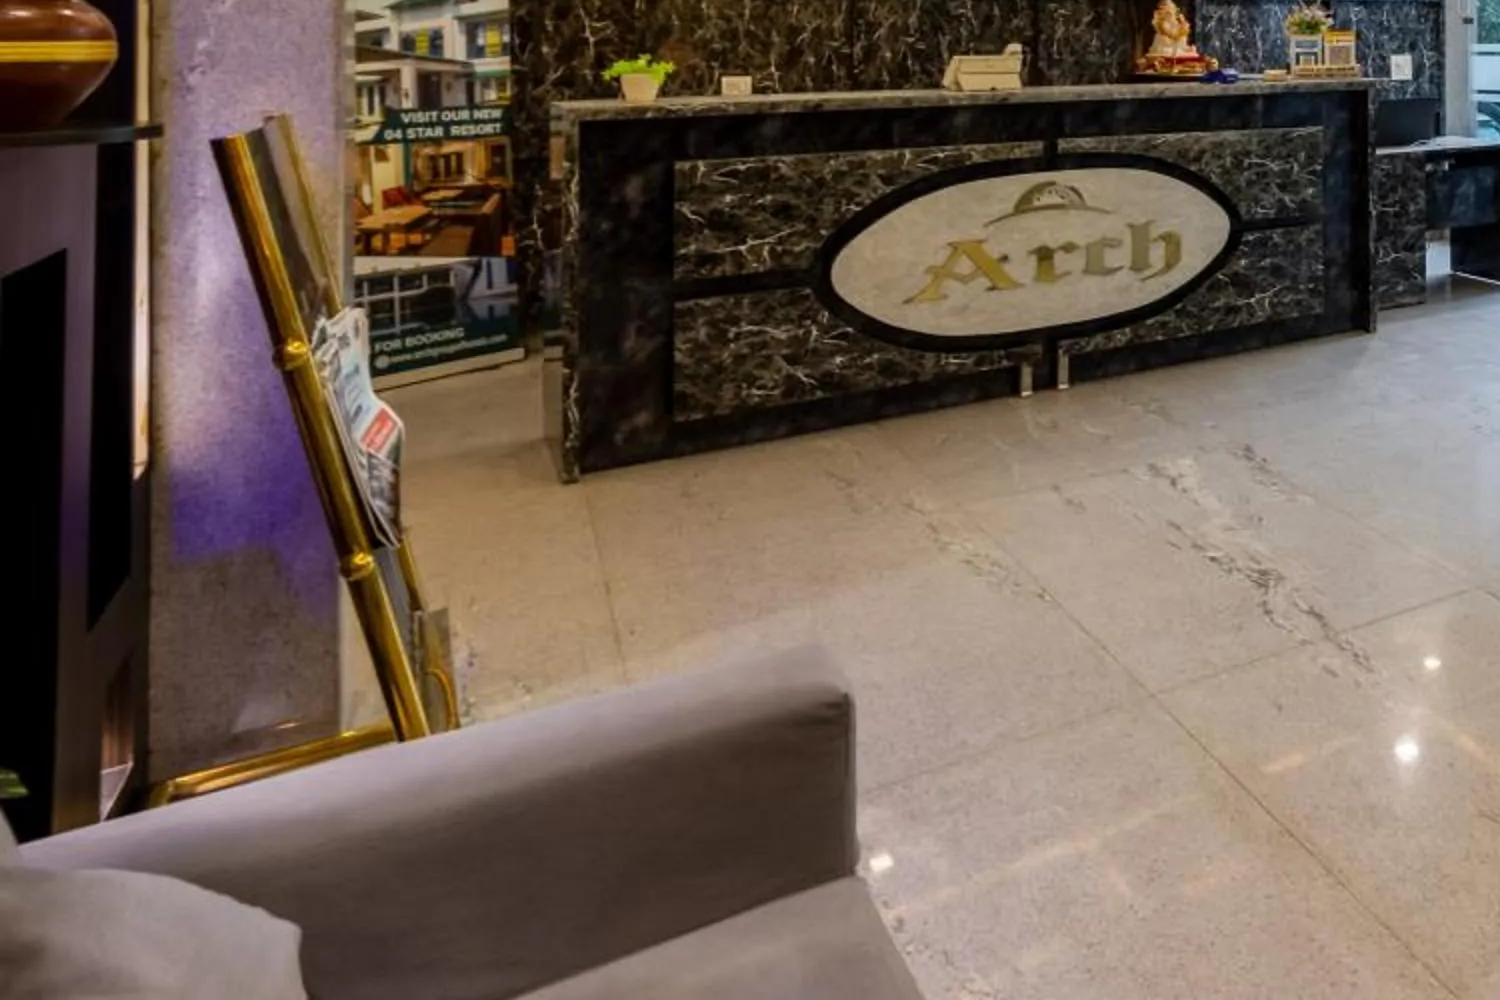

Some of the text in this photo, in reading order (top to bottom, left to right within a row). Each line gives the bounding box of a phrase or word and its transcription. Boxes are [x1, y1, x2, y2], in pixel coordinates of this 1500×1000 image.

[402, 109, 502, 123] VISIT OUR NEW
[406, 126, 444, 138] STAR
[451, 123, 501, 136] RESORT
[902, 218, 1183, 306] Arch
[374, 338, 403, 352] FOR
[406, 328, 464, 347] BOOKING
